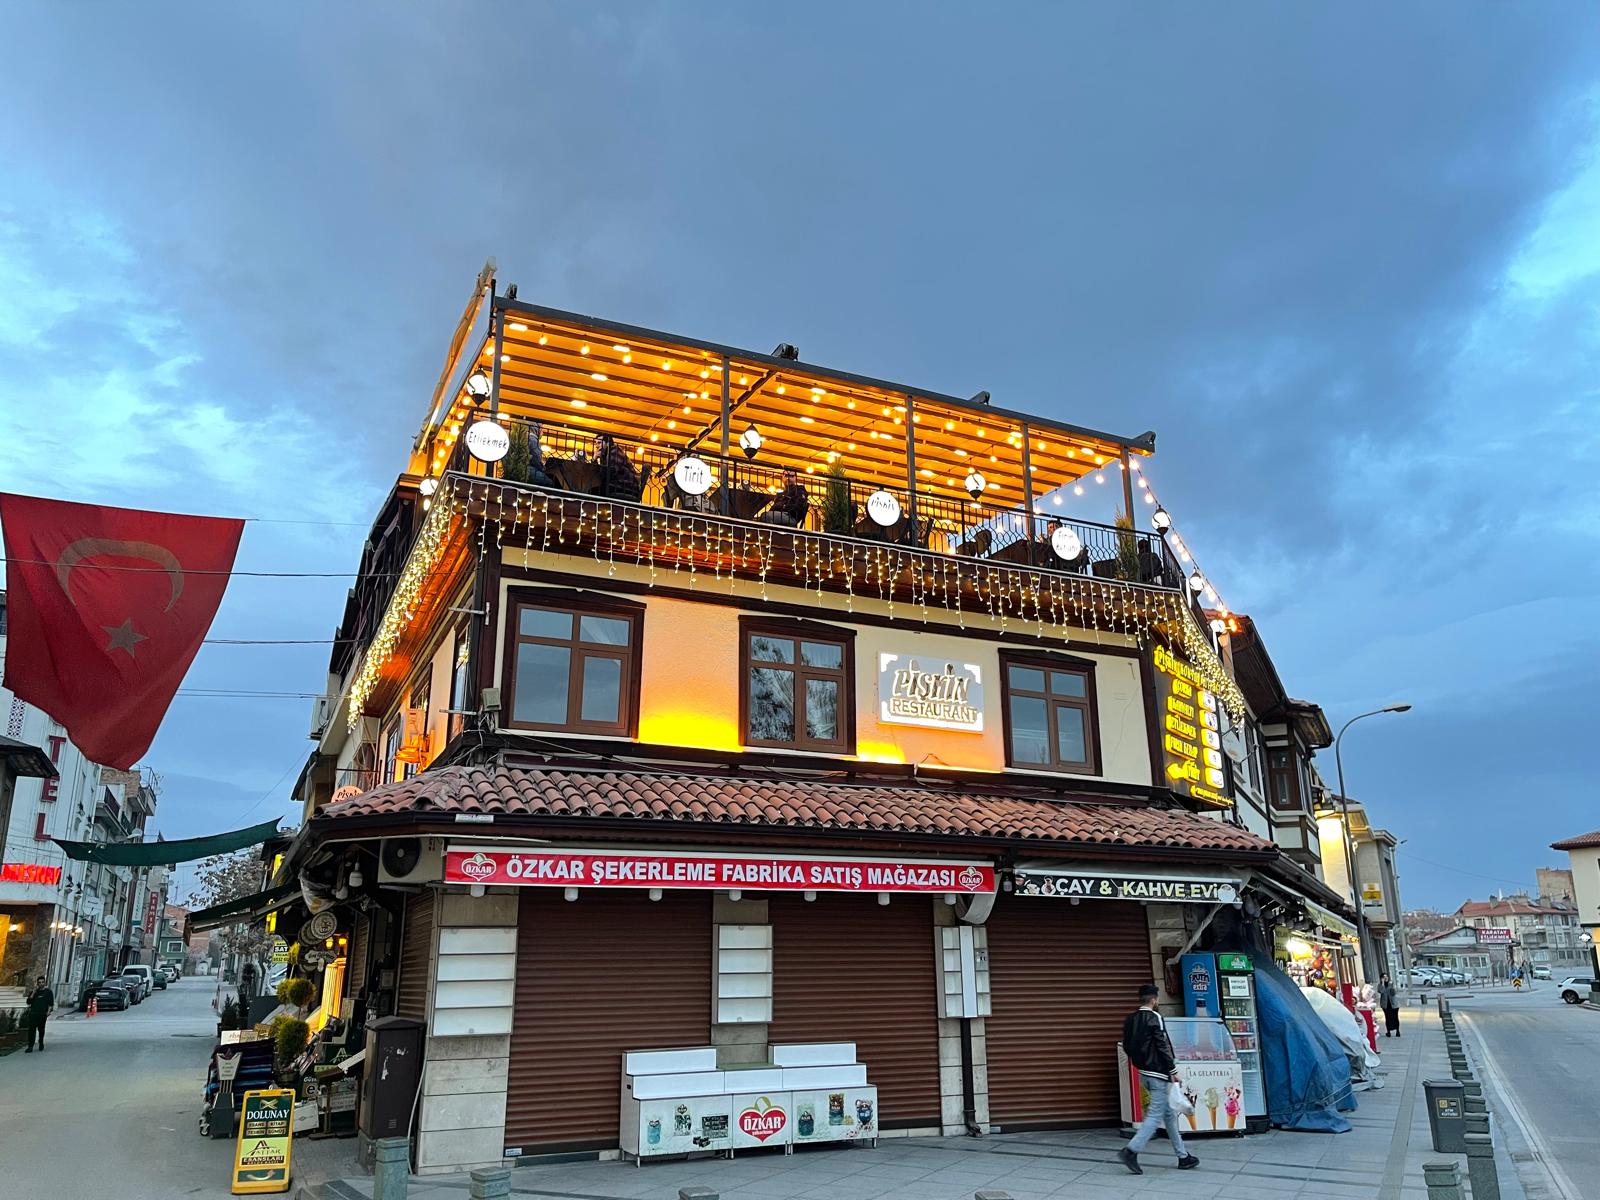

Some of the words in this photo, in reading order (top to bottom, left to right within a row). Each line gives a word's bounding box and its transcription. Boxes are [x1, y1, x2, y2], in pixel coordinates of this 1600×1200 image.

[684, 465, 703, 484] Tirit
[891, 699, 977, 722] RESTAURANT
[465, 863, 493, 874] ÖZKAR
[506, 855, 584, 879] ÖZKAR
[591, 860, 716, 885] ŞEKERLEME
[722, 861, 805, 884] FABRİKA
[810, 865, 862, 889] SATIŞ
[867, 864, 955, 887] MAĞAZASI
[1055, 877, 1094, 896] ÇAY
[1099, 880, 1112, 895] &
[1123, 881, 1186, 898] KAHVE
[1193, 983, 1208, 991] extra
[246, 1109, 290, 1120] DOLUNAY
[743, 1116, 781, 1131] ÖZKAR
